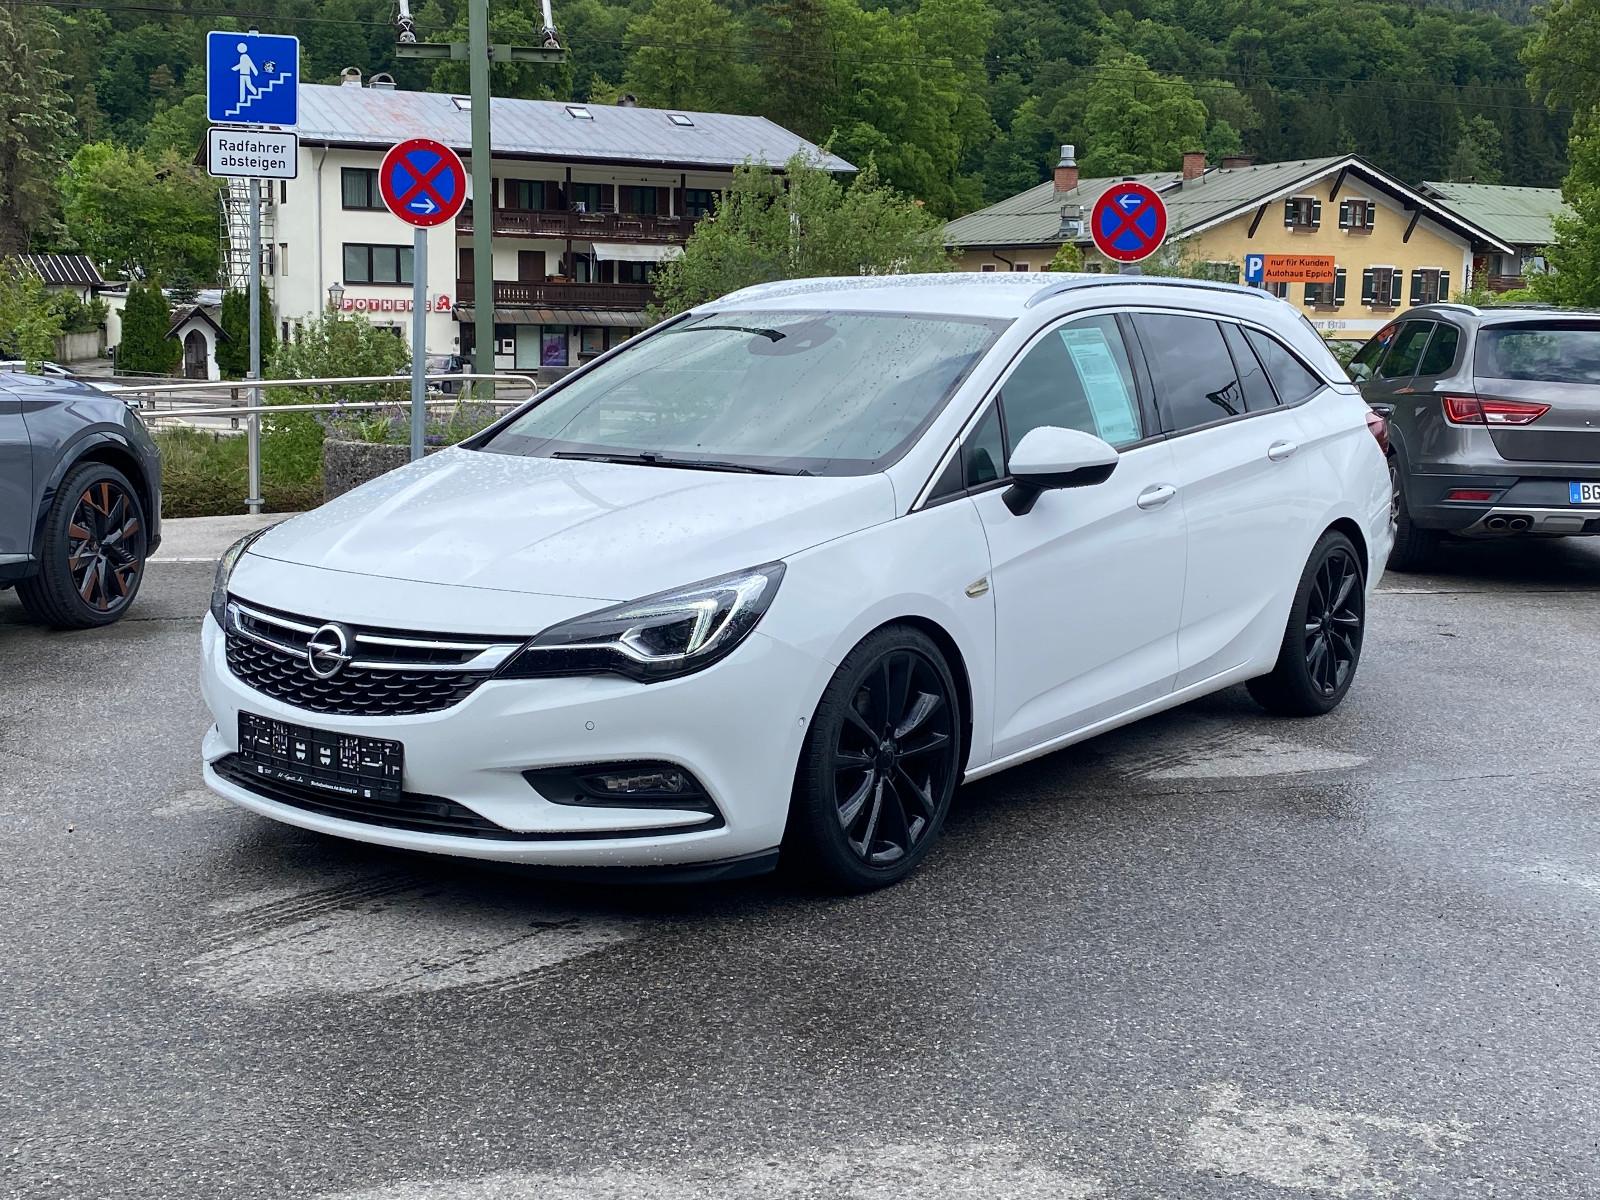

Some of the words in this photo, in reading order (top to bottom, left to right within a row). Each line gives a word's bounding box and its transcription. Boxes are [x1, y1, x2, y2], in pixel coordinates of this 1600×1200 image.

[219, 139, 287, 153] Radfahrer
[221, 155, 286, 170] absteigen
[1248, 257, 1262, 277] P
[1286, 258, 1297, 266] für
[1266, 269, 1304, 277] Autohaus
[1305, 270, 1333, 279] Eppich
[337, 299, 431, 311] POTHEKE
